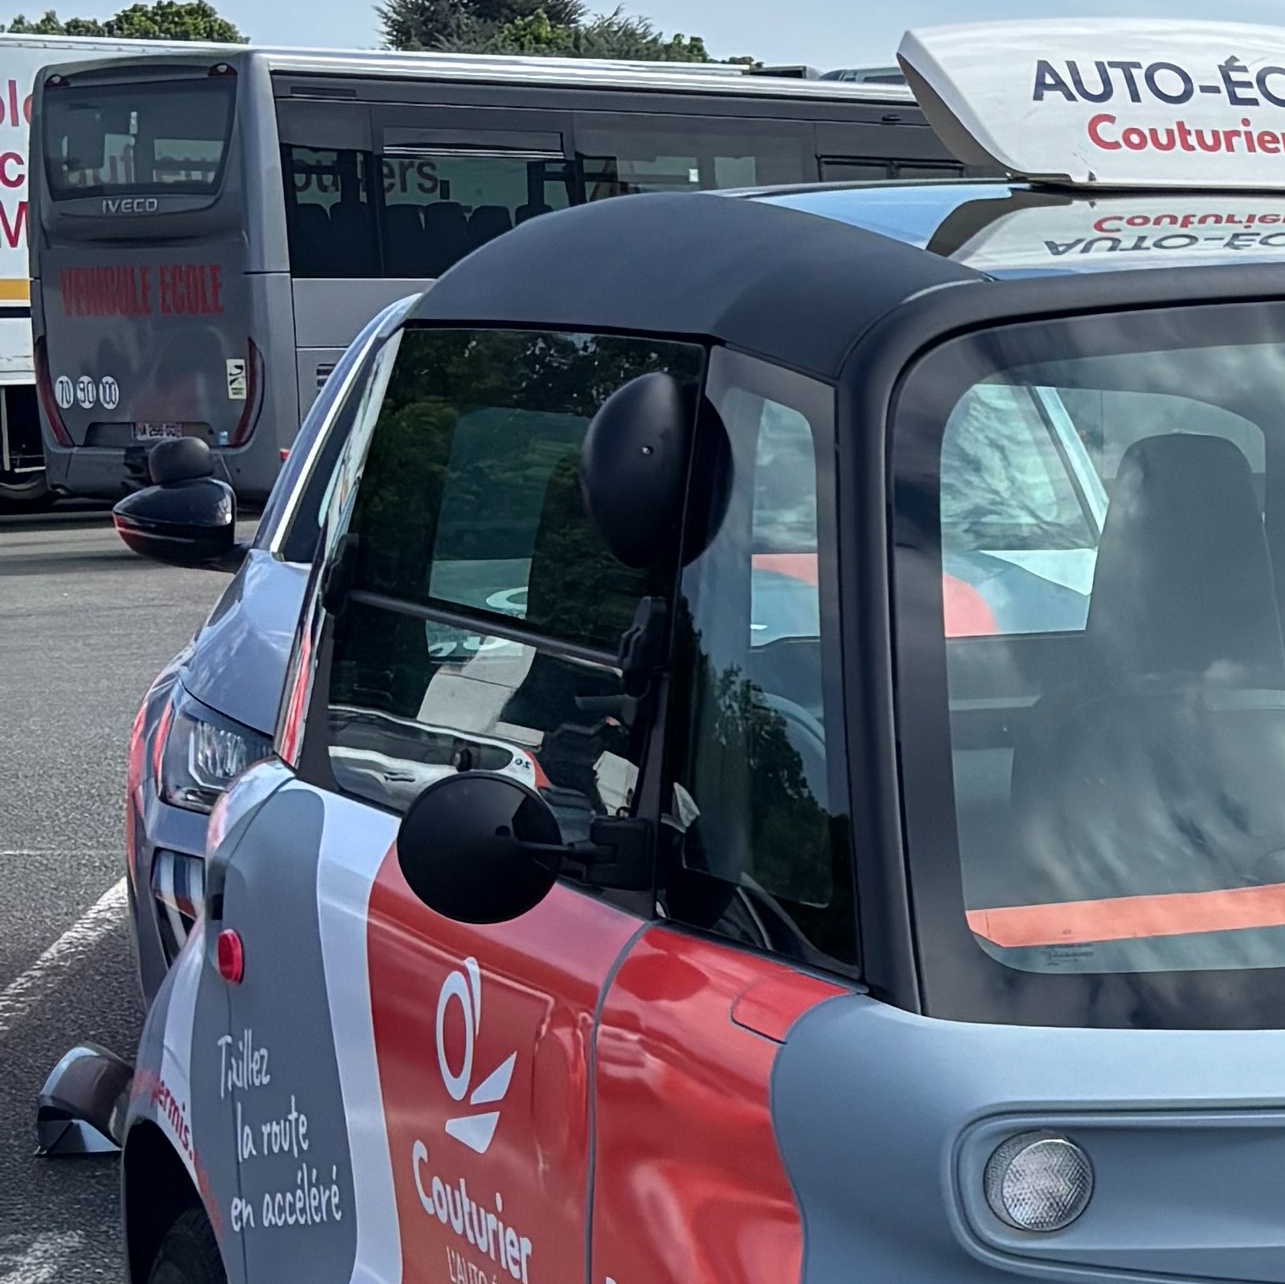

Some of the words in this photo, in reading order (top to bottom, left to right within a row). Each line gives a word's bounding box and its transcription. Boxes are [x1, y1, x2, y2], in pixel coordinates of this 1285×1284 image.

[102, 198, 158, 213] IVECO
[158, 263, 224, 315] ECOLE
[236, 1101, 257, 1163] la
[262, 1094, 309, 1158] route
[231, 1197, 255, 1232] en
[263, 1163, 342, 1227] accéléré
